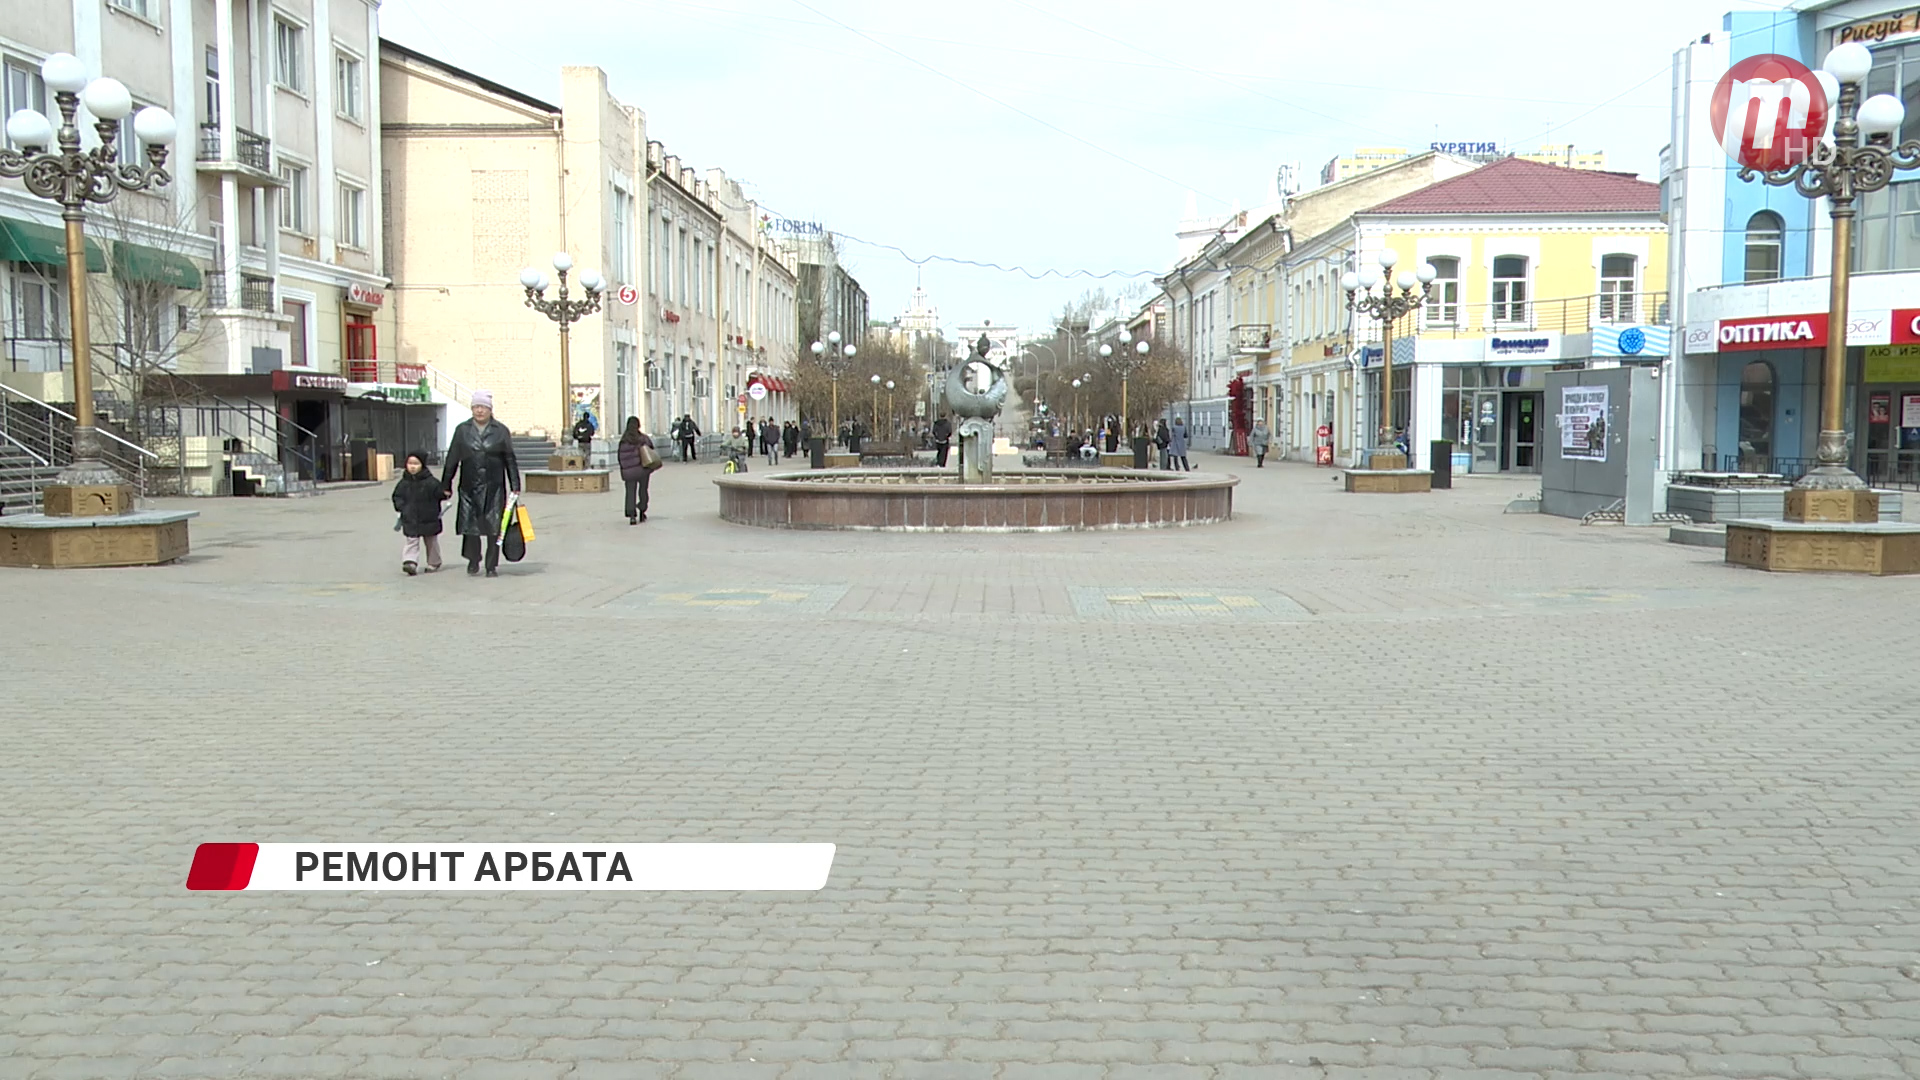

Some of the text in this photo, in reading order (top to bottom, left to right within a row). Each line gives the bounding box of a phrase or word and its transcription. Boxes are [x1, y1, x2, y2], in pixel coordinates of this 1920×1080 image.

[1840, 13, 1903, 44] Рисуй
[1430, 142, 1496, 153] БУРЯТИЯ
[775, 218, 823, 235] FORUM
[1720, 321, 1815, 344] ОПТИКА
[1491, 338, 1549, 349] Венеция
